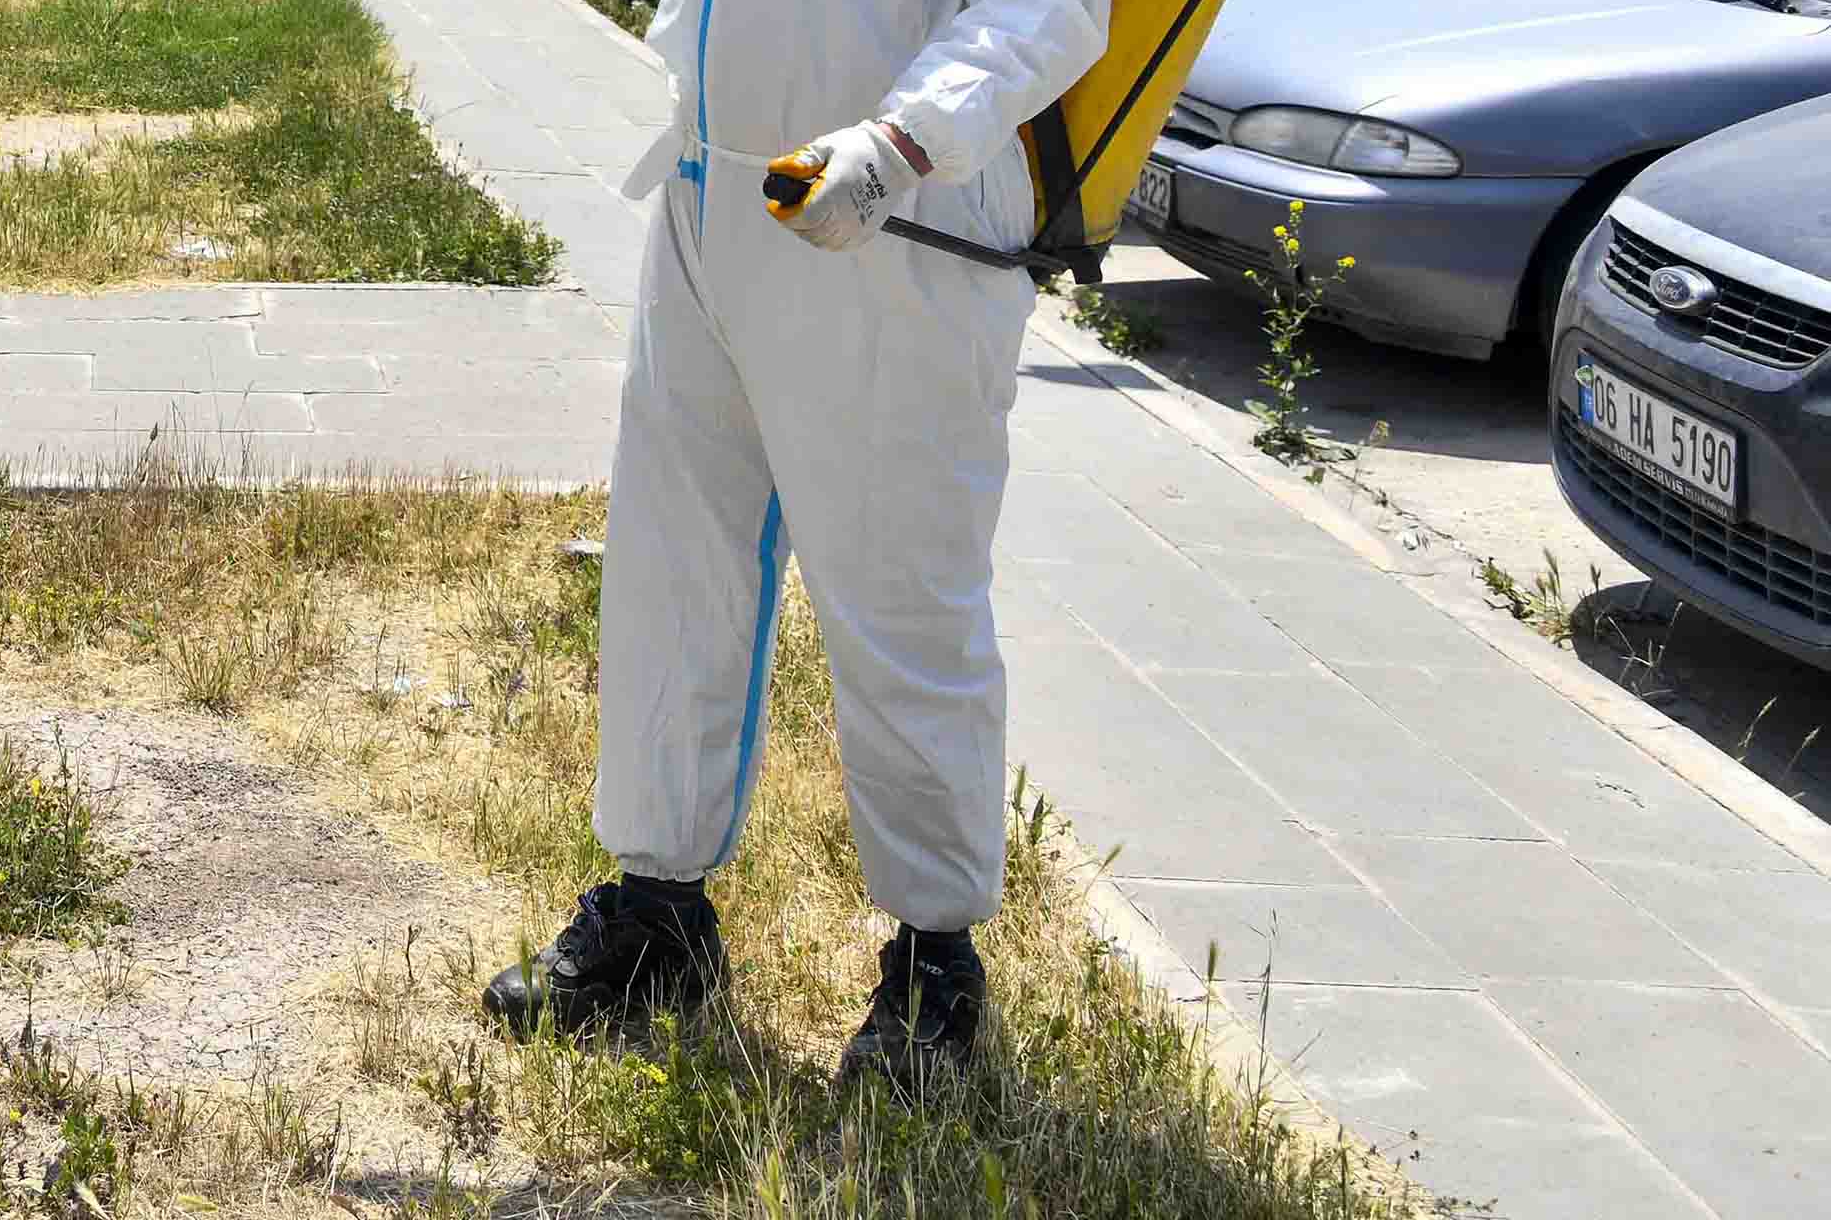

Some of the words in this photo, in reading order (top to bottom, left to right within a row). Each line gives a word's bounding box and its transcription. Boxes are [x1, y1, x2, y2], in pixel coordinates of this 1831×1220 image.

[1594, 375, 1617, 429] 06
[1629, 393, 1655, 455] HA
[1671, 416, 1731, 492] 5190
